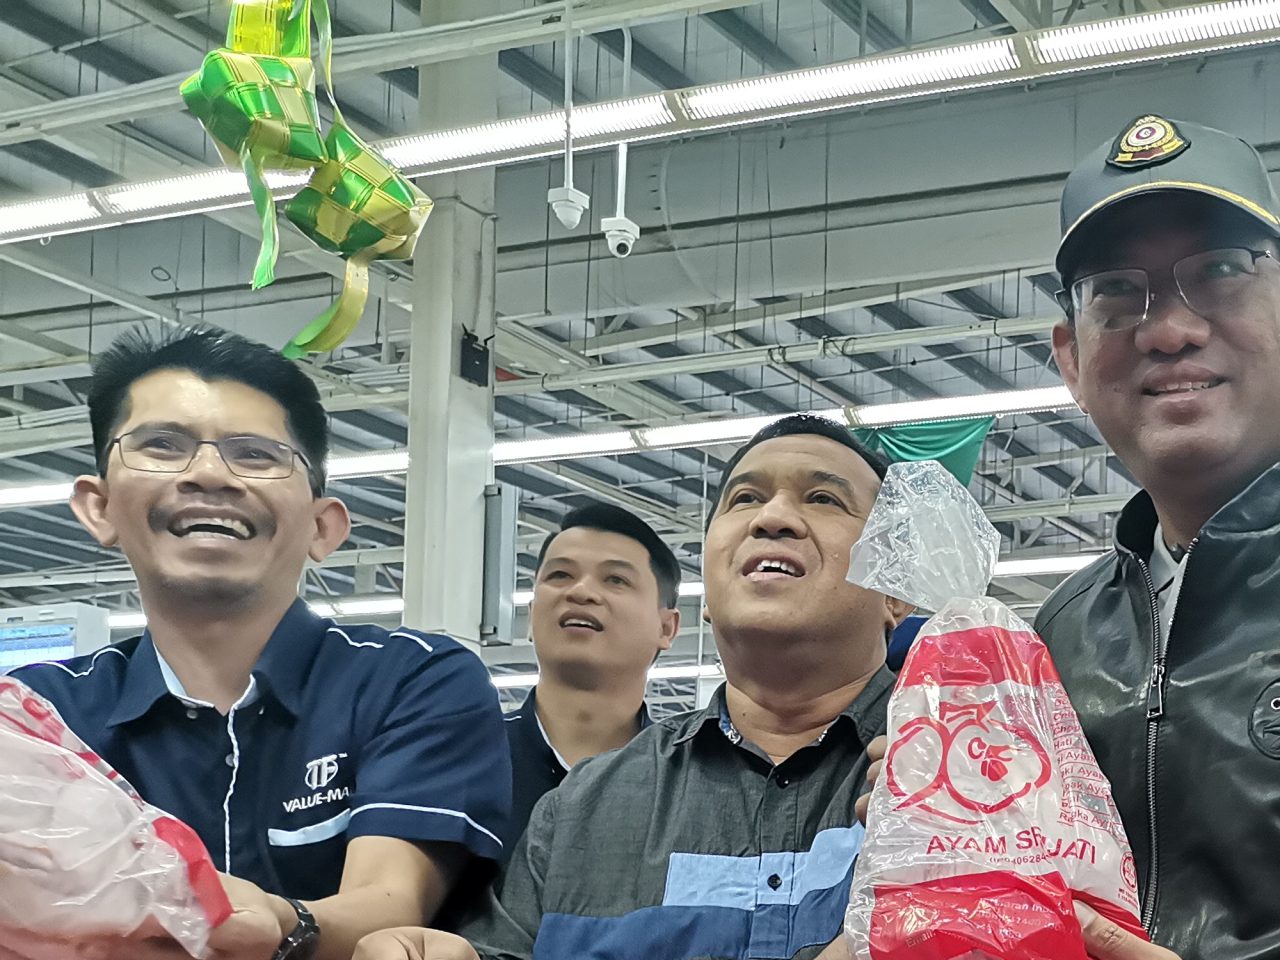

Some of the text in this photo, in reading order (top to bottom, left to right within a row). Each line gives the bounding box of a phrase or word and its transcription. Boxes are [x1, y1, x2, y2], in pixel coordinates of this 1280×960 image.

[282, 786, 350, 812] VALUE-MA
[926, 835, 1007, 855] AYAM
[1047, 838, 1096, 864] JATI
